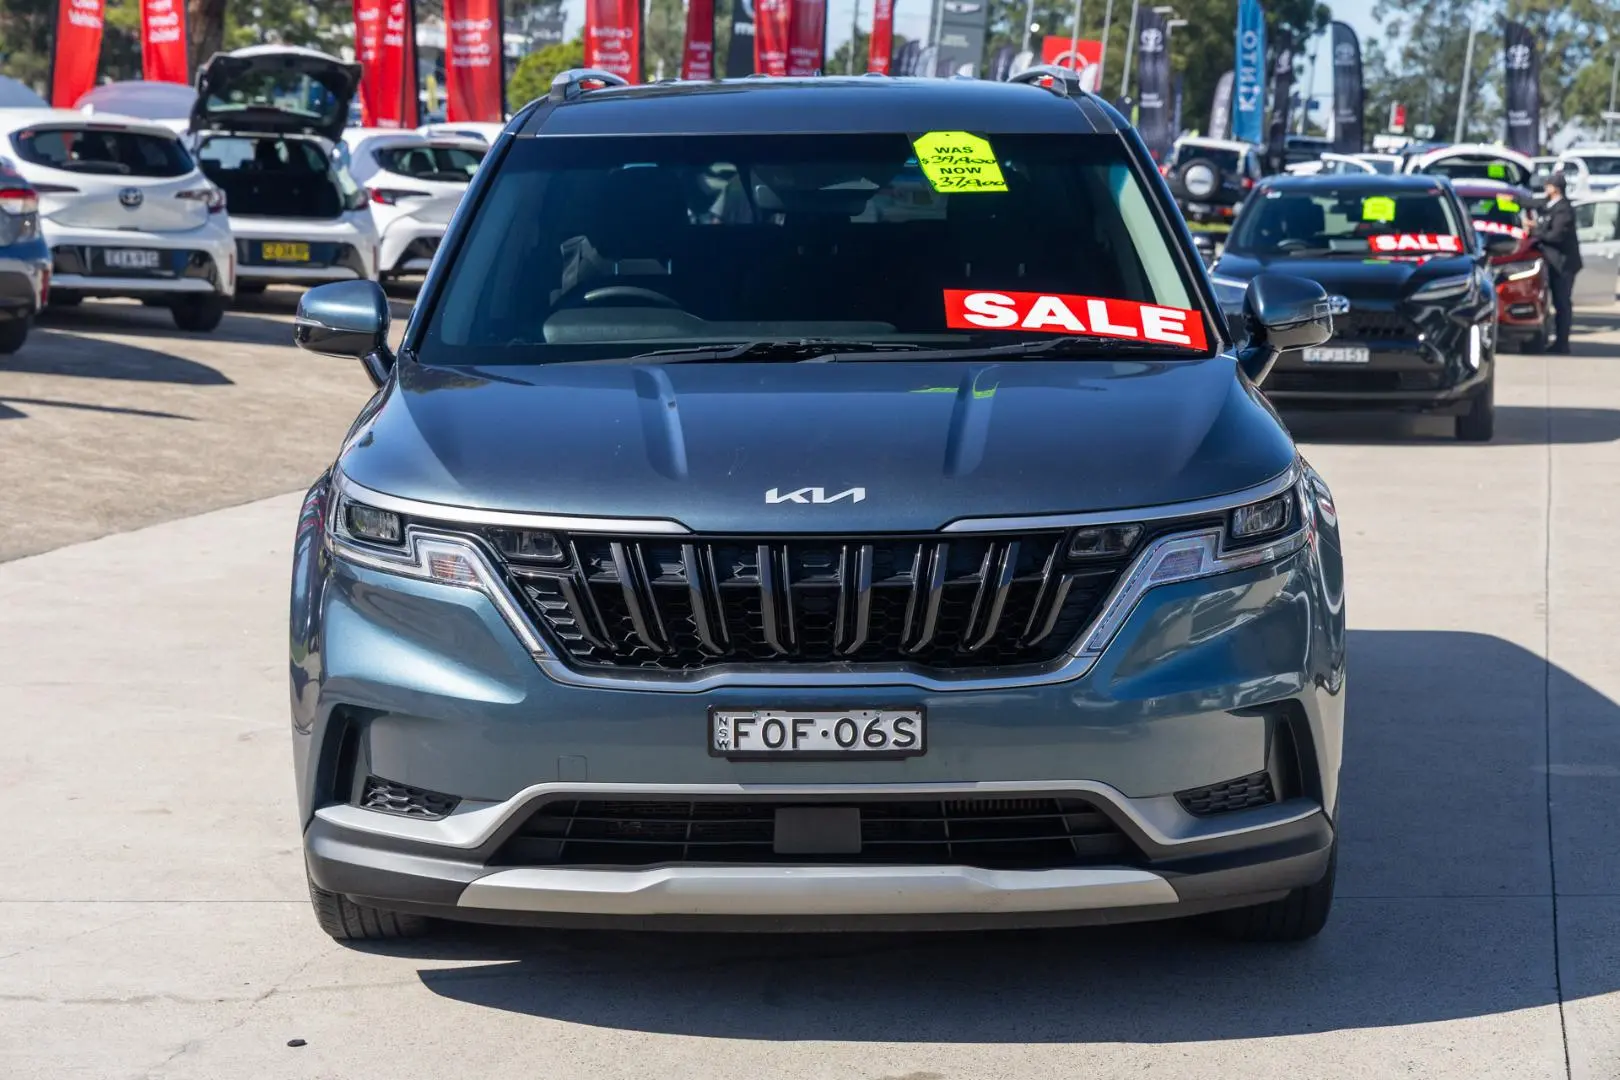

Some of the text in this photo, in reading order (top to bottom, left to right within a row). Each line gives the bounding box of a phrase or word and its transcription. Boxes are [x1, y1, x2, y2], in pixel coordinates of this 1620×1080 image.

[934, 146, 974, 154] WAS
[939, 167, 982, 175] NOW
[1472, 219, 1524, 239] SALE
[1375, 235, 1458, 251] SALE
[963, 292, 1192, 345] SALE
[765, 487, 866, 503] KIA
[717, 717, 730, 749] NSW
